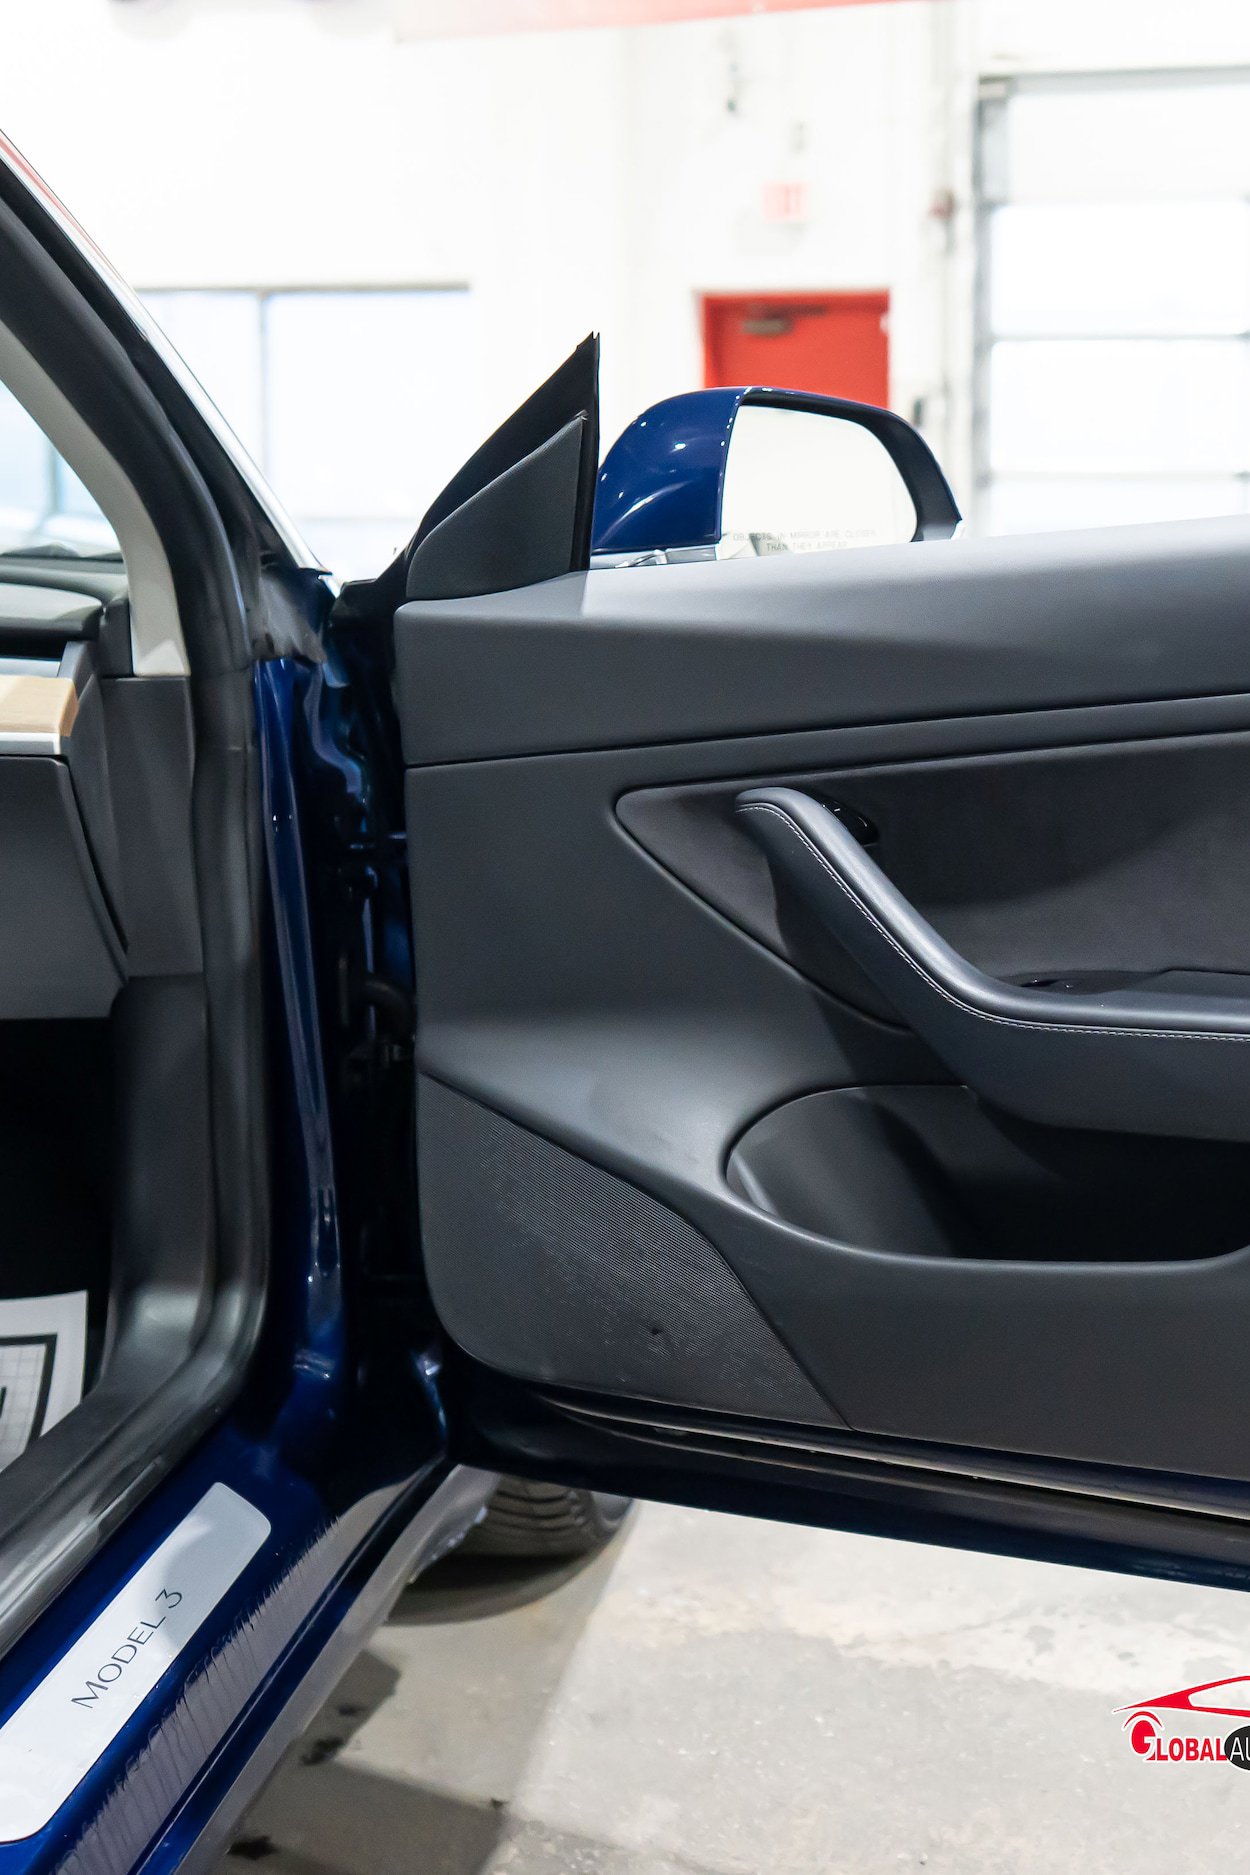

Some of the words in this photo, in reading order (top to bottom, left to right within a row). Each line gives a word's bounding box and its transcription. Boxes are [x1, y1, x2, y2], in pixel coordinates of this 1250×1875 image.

[766, 542, 789, 551] THAN
[71, 1615, 166, 1708] MODEL
[155, 1588, 183, 1609] 3
